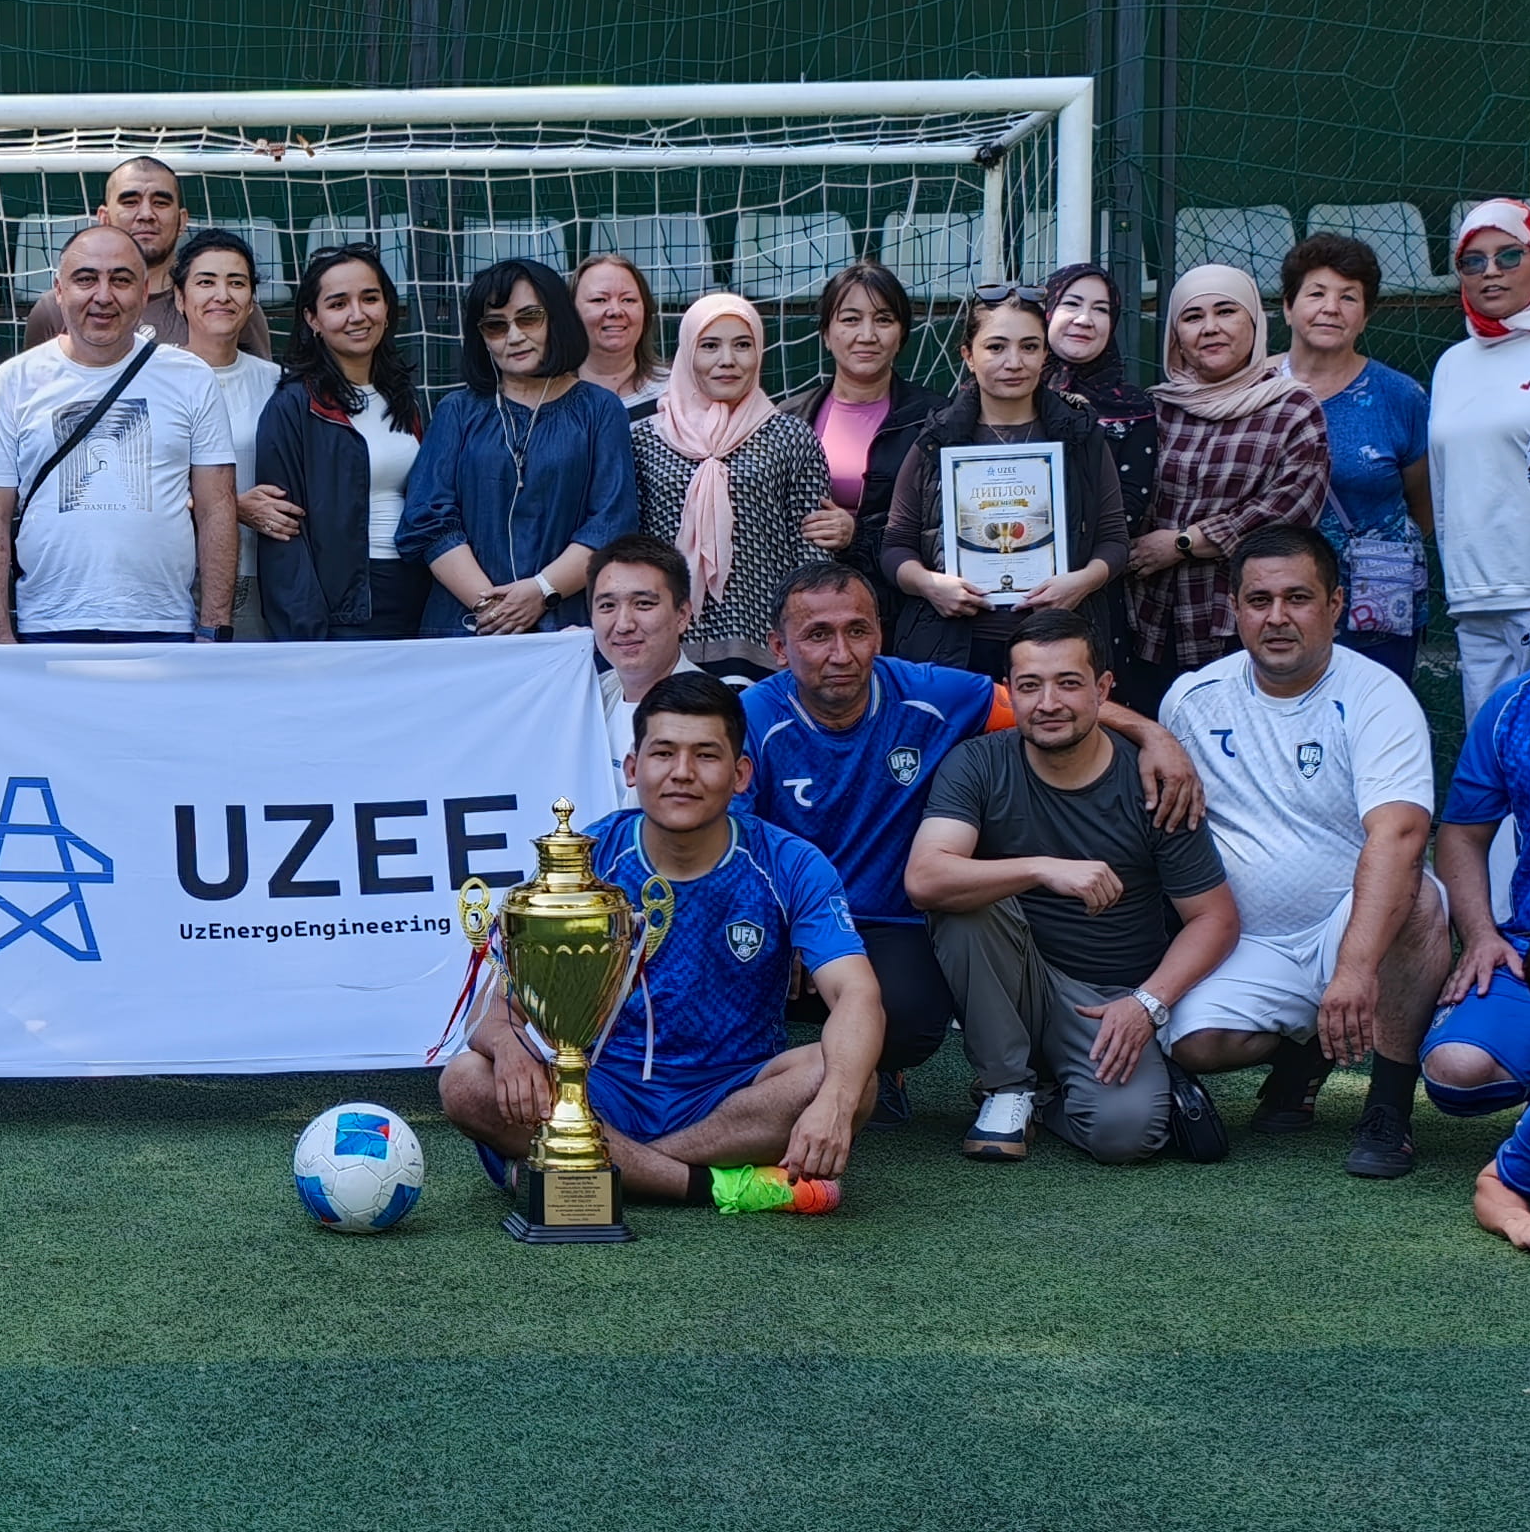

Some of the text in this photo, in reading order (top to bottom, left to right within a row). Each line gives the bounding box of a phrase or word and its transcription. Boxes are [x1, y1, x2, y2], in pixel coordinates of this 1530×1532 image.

[969, 485, 1037, 500] ДИПЛОМ
[83, 502, 128, 511] DANIEL'S
[891, 753, 917, 770] UFA
[174, 793, 525, 901] UZEE
[179, 914, 452, 943] UzEnergoEngineering
[732, 926, 759, 944] UFA
